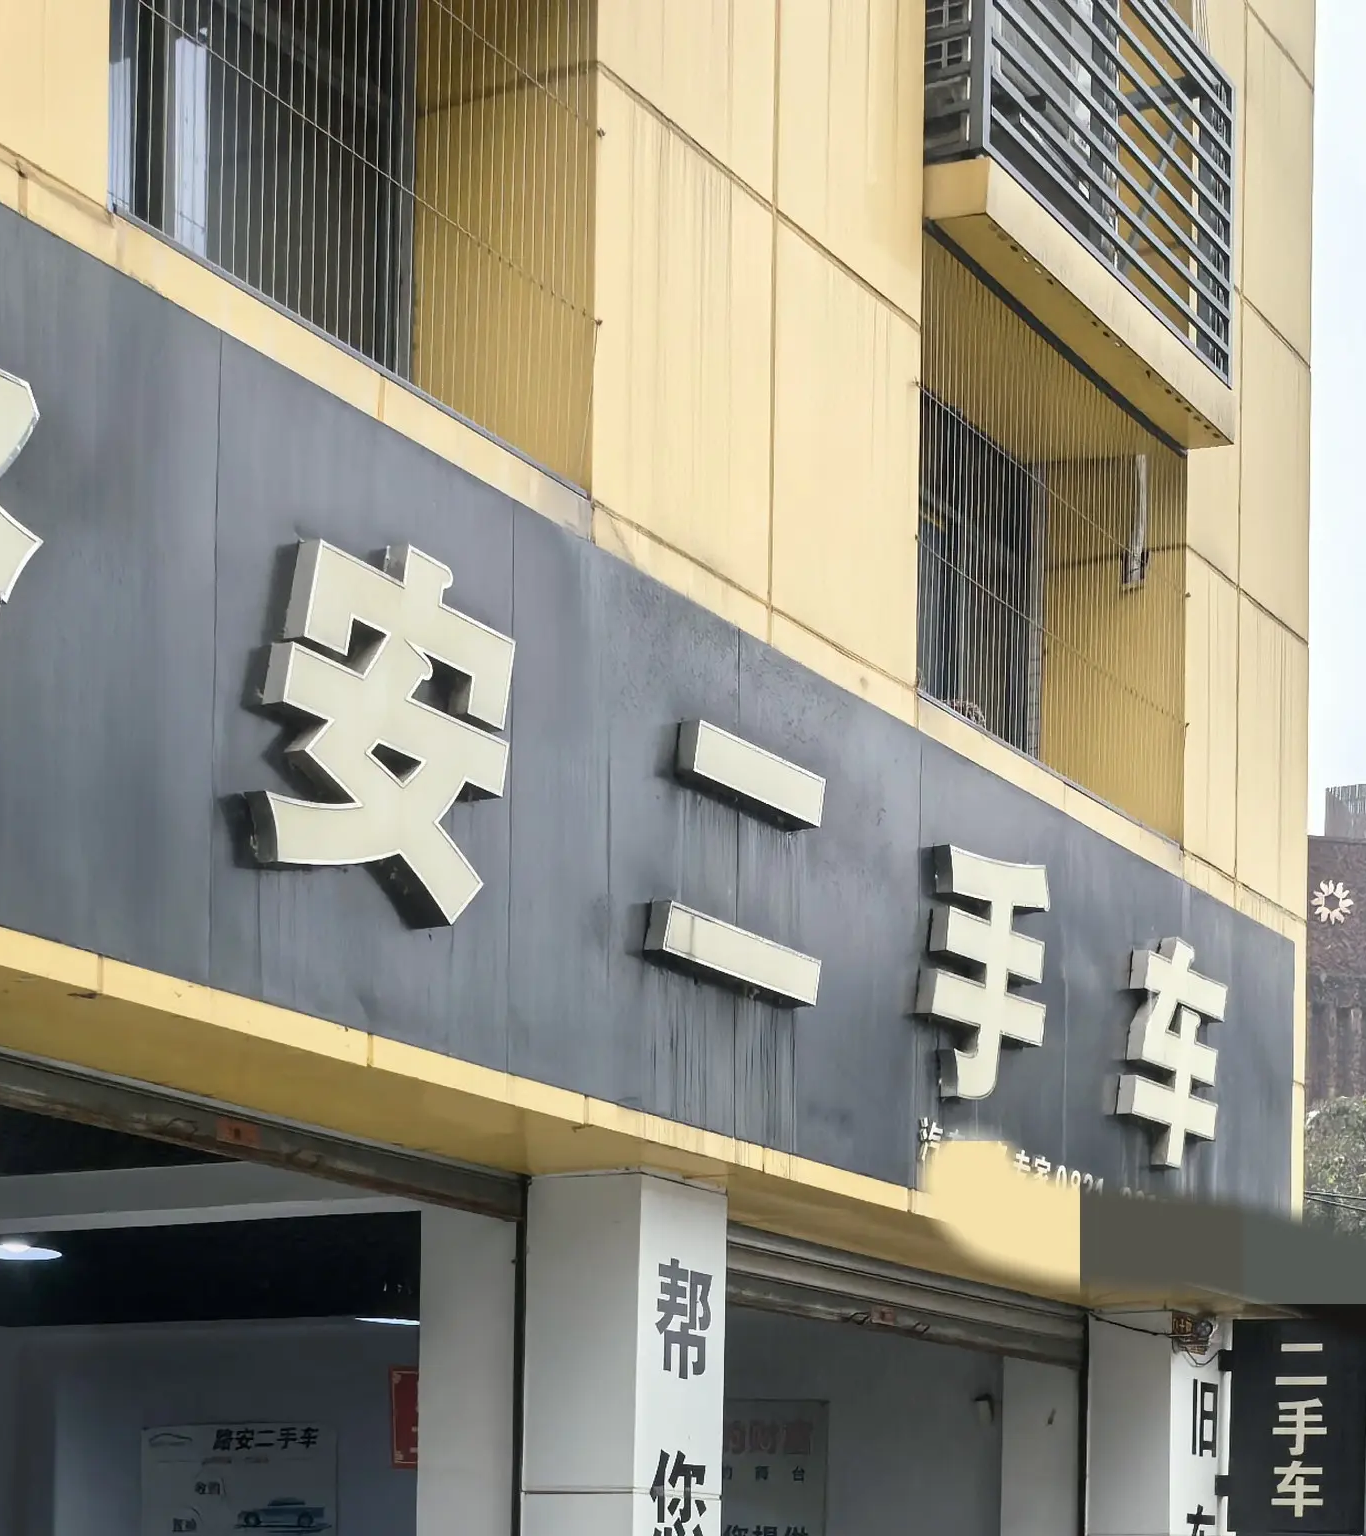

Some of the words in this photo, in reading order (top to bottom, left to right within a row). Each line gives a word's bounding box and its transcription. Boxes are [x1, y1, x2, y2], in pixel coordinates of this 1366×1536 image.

[213, 1427, 319, 1450] 路安二手车
[1271, 1343, 1327, 1517] 二手车
